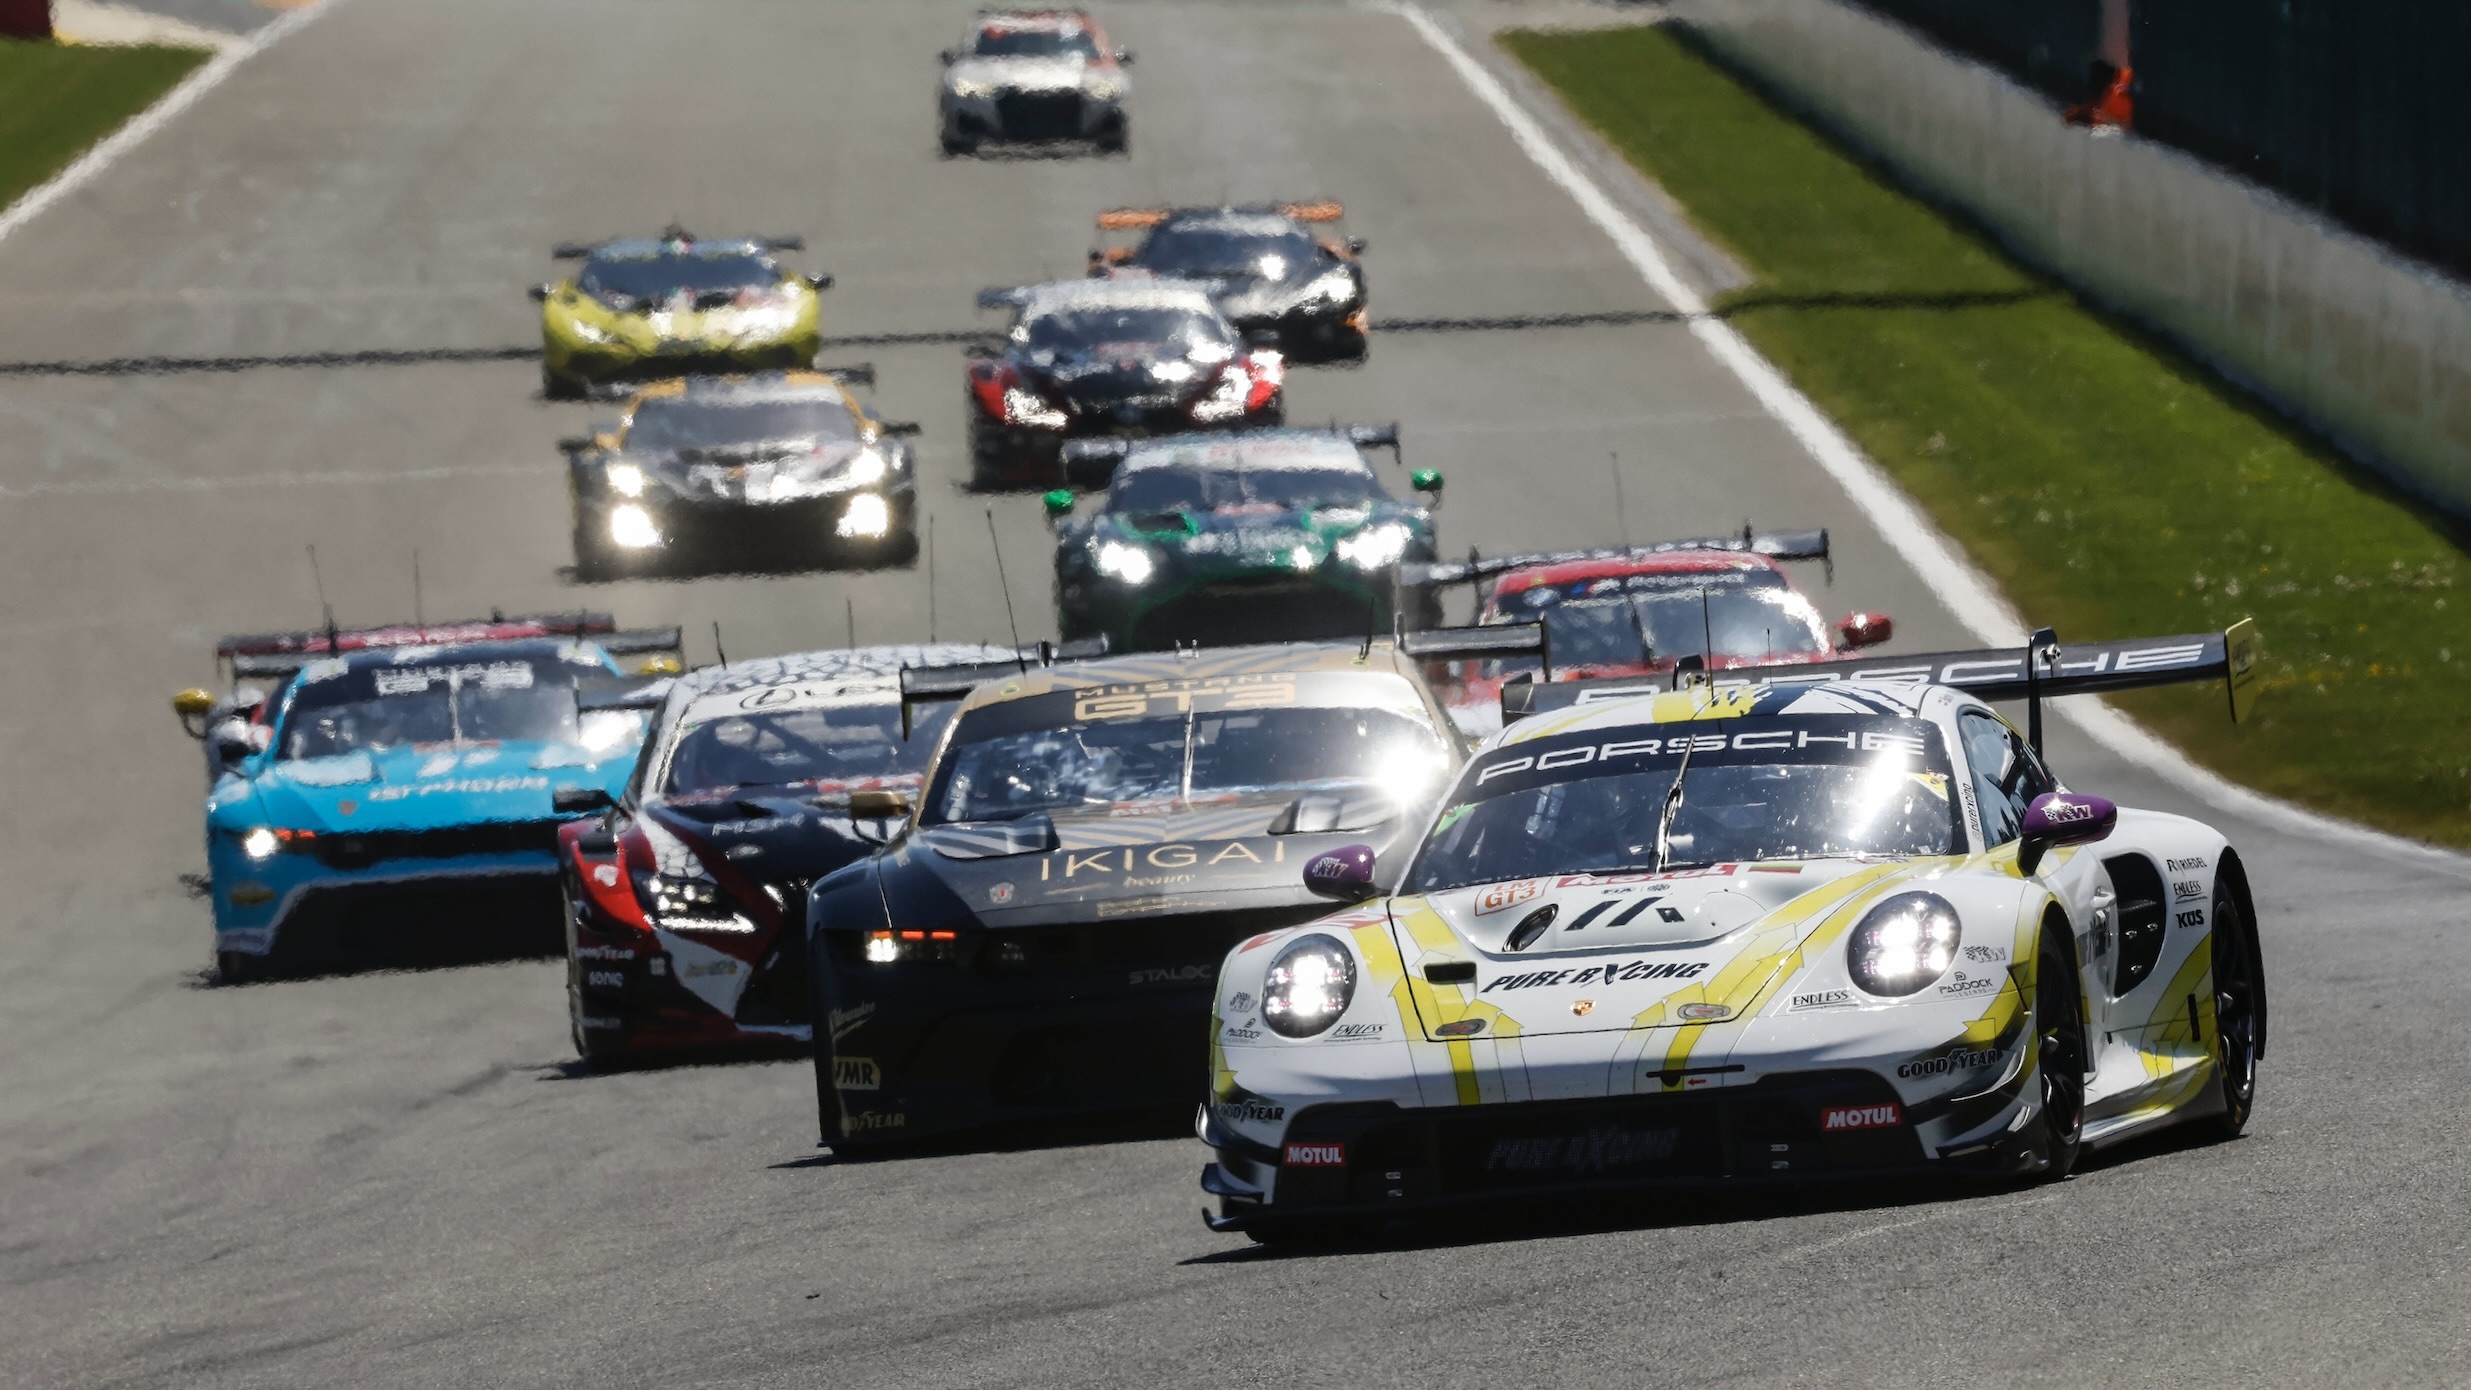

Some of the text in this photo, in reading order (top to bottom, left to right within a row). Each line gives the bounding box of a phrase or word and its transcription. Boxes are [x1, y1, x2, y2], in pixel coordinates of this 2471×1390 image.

[1075, 673, 1297, 699] MUSTANG
[1074, 683, 1296, 720] GT3
[1476, 730, 1925, 786] PORSCHE
[1041, 841, 1285, 881] IKIGAI
[1123, 873, 1196, 889] beauty
[2173, 880, 2202, 895] ENDLESS
[1485, 887, 1536, 908] GT3
[1129, 965, 1212, 984] STALOC
[1938, 978, 1993, 994] PADDOCK
[1793, 990, 1849, 1006] ENDLESS
[1333, 1023, 1388, 1036] ENDLESS
[1826, 1106, 1897, 1129] MOTUL
[1287, 1146, 1342, 1163] MOTUL
